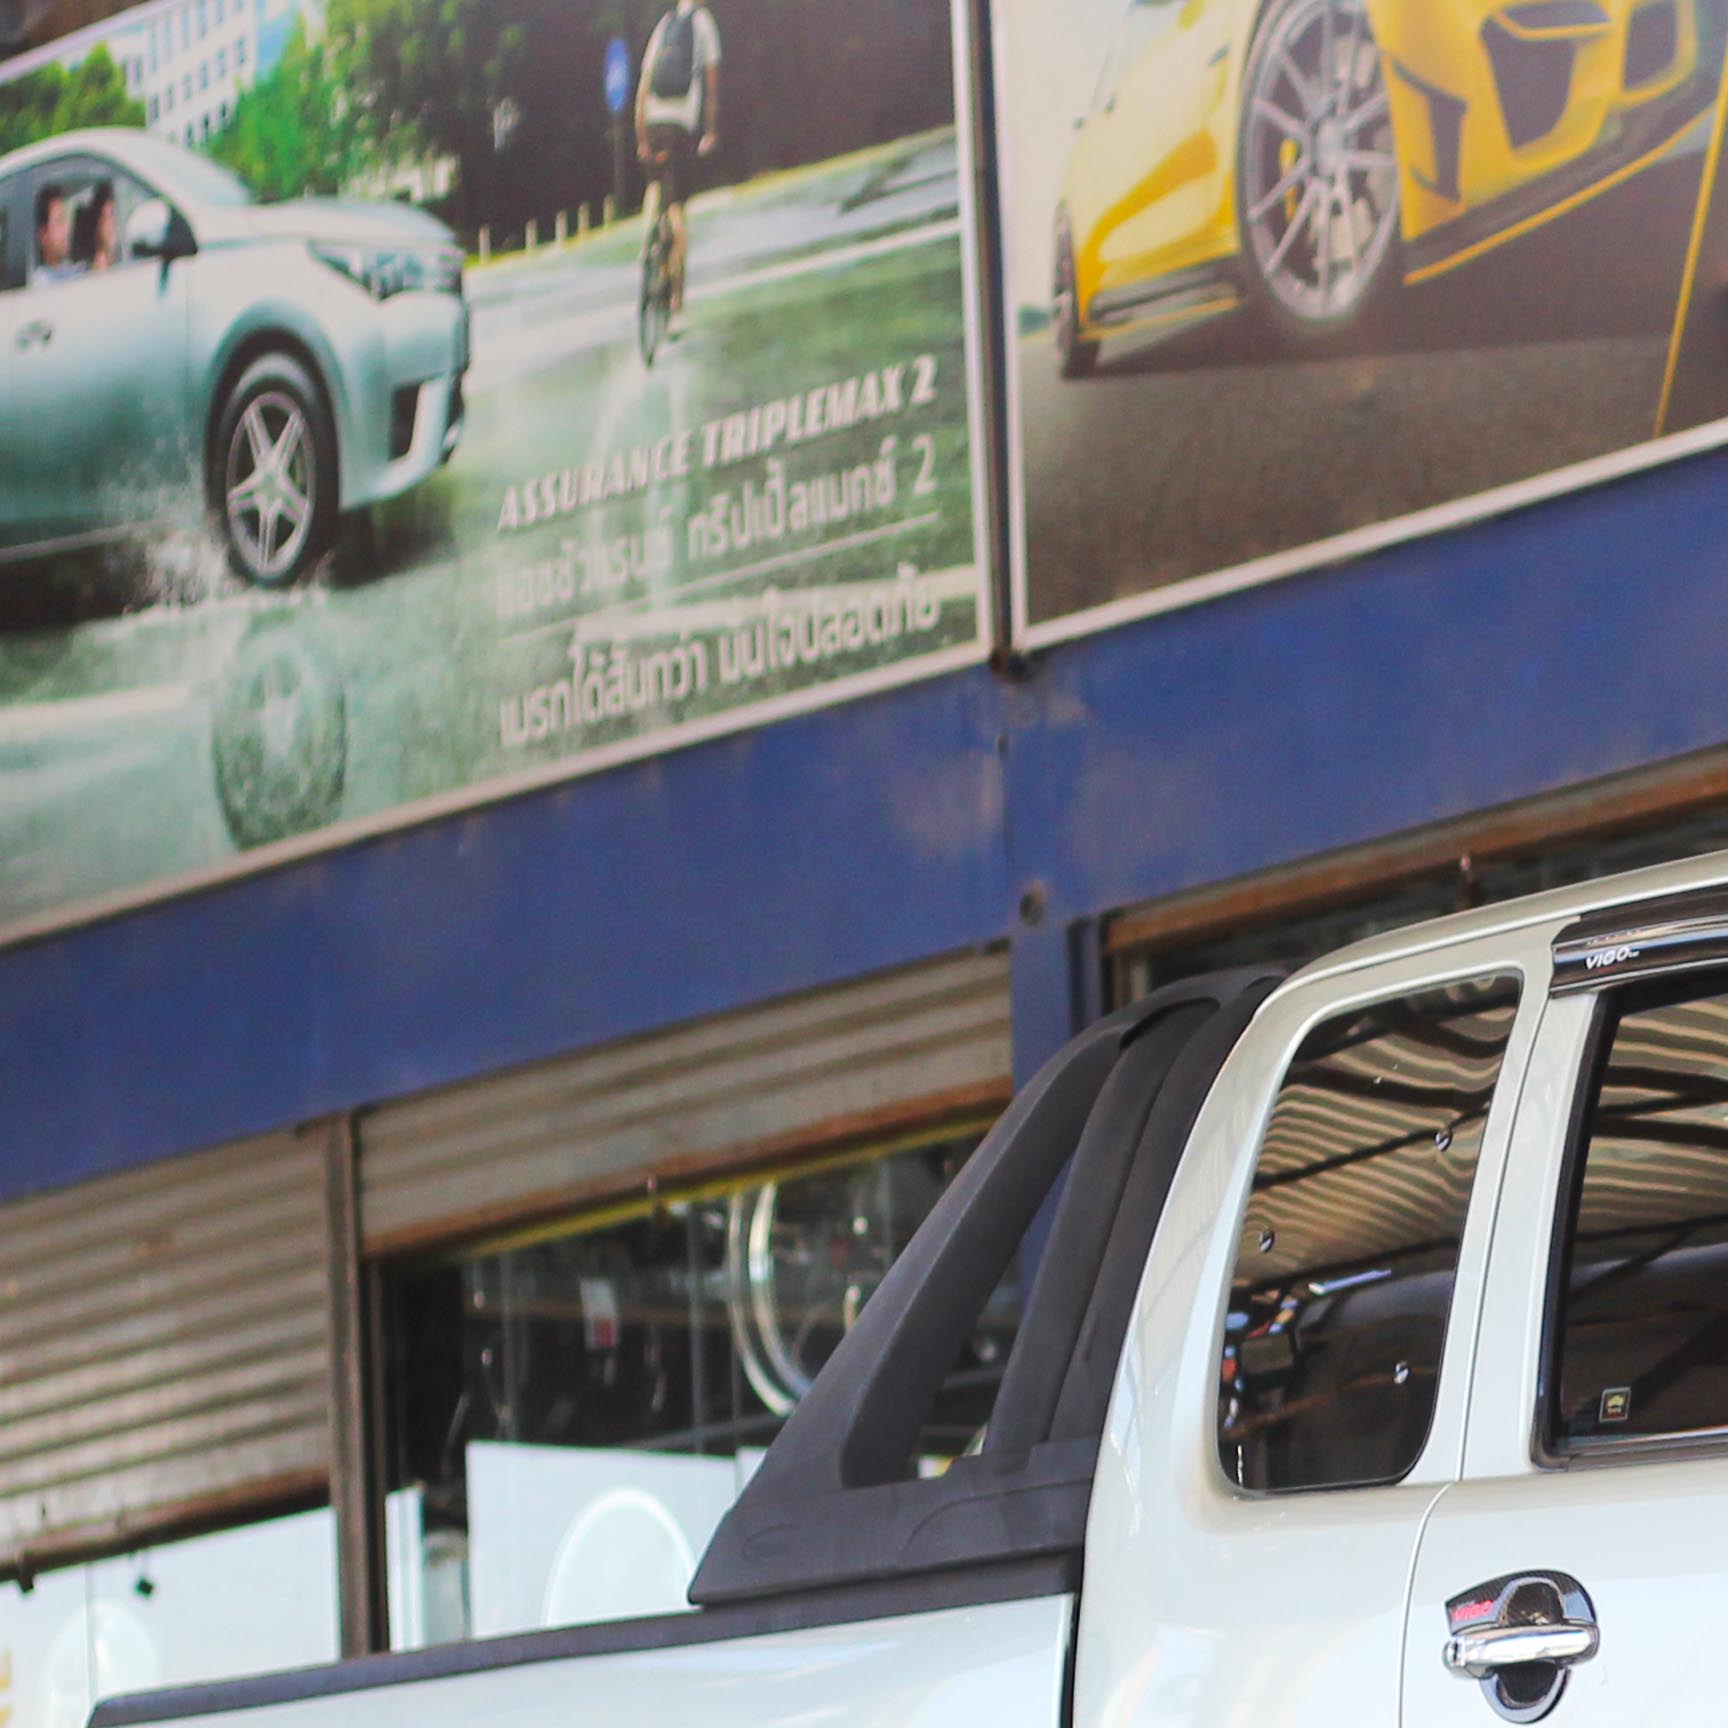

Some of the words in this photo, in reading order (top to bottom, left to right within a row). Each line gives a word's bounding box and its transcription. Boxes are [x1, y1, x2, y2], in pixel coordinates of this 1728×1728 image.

[499, 431, 693, 530] ASSURANCE
[703, 363, 906, 469] TRIPLEMAX
[910, 355, 937, 404] 2
[913, 435, 937, 497] 2
